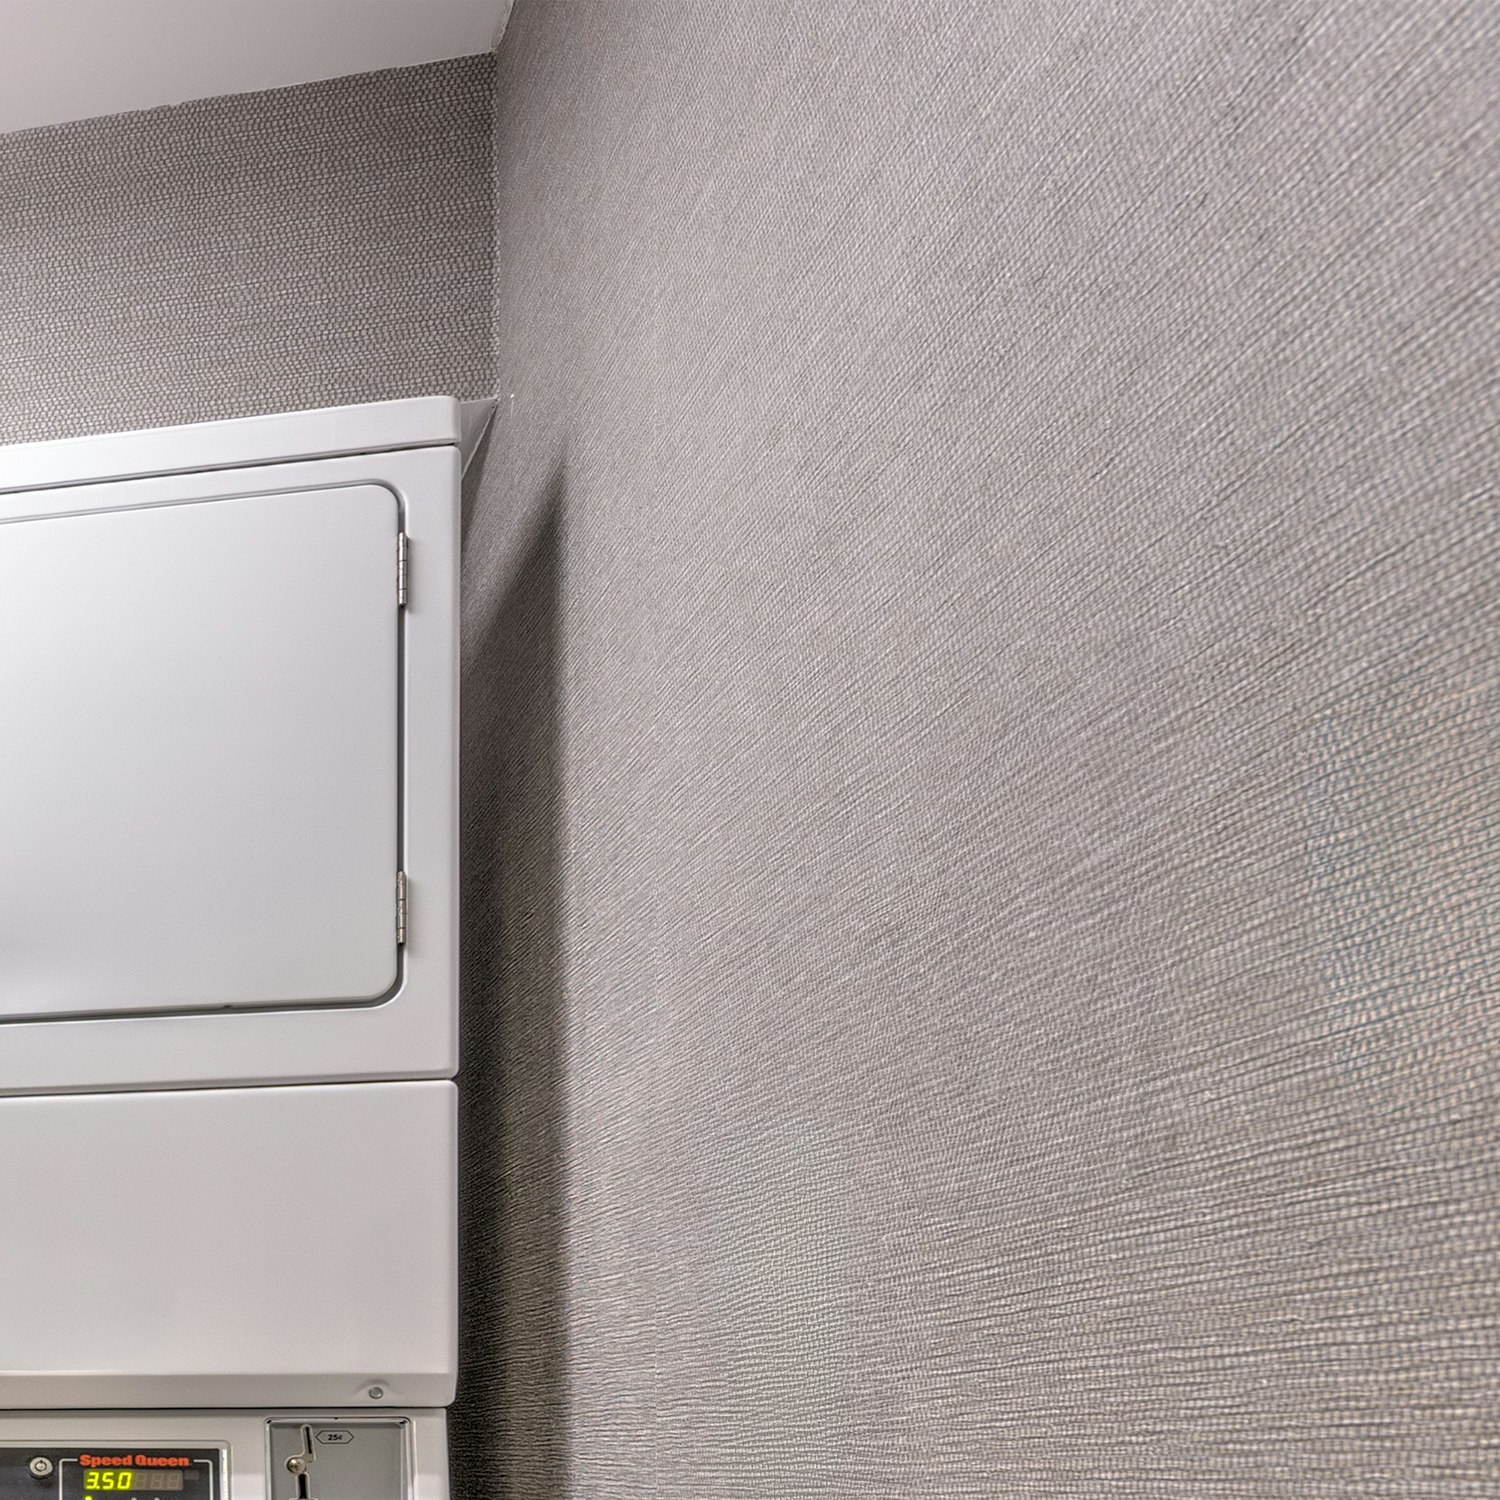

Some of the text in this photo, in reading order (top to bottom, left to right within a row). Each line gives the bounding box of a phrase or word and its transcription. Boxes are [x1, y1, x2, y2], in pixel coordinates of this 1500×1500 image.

[80, 1455, 189, 1467] Speed Queen
[86, 1472, 132, 1490] 3.50
